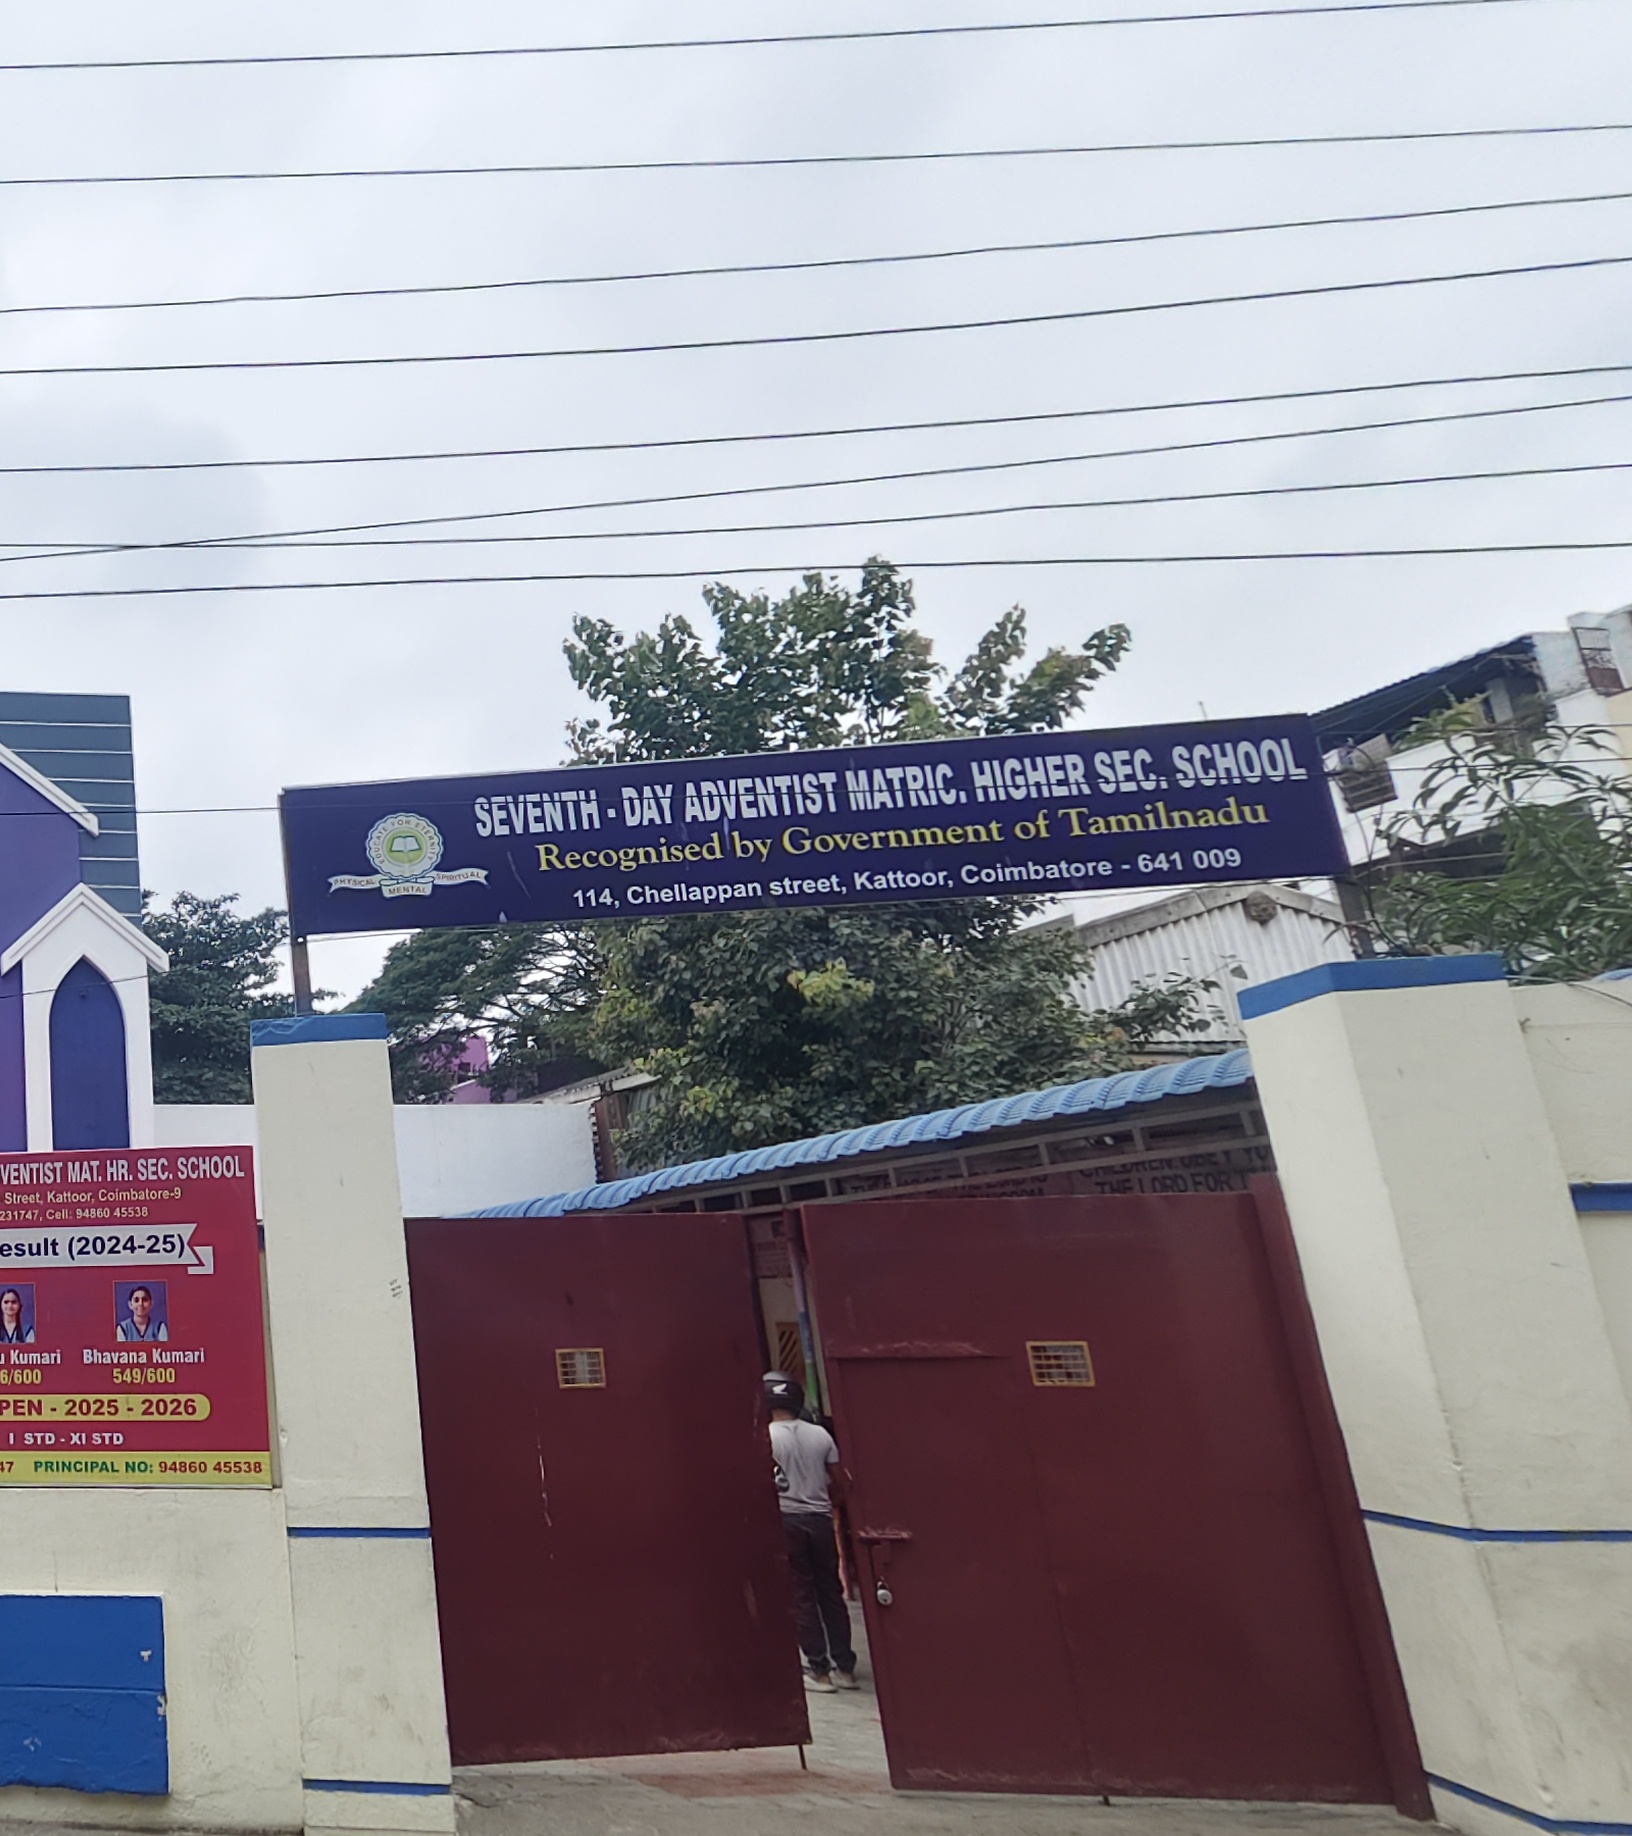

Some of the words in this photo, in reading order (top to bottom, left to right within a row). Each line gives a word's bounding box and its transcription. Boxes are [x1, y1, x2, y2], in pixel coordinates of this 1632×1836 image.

[474, 789, 600, 837] SEVENTH
[621, 784, 673, 827] DAY
[685, 770, 838, 823] ADVENTIST
[845, 763, 967, 811] MATRIC.
[971, 754, 1091, 802] HIGHER
[1094, 748, 1168, 794] SEC.
[1172, 738, 1308, 789] SCHOOL
[374, 827, 388, 865] EDUCATE
[391, 819, 412, 827] FOR
[415, 822, 438, 862] ETERNITY
[534, 831, 724, 872] Recognised
[732, 831, 772, 862] by
[782, 819, 1004, 856] Government
[1014, 810, 1052, 840] of
[1058, 796, 1270, 838] Tamilnadu
[333, 878, 378, 887] PHYSICAL
[436, 871, 482, 881] SPIRITUAL
[573, 888, 620, 909] 114,
[627, 879, 762, 905] Chellappan
[769, 873, 847, 895] street,
[854, 866, 954, 889] Kattoor,
[961, 859, 1112, 885] Coimbatore
[1137, 851, 1183, 874] 641
[1193, 848, 1241, 869] 009
[388, 886, 428, 895] MENTAL
[67, 1161, 102, 1183] MAT.
[107, 1159, 133, 1182] HR.
[137, 1157, 173, 1181] SEC.
[177, 1155, 245, 1179] SCHOOL
[1191, 1171, 1233, 1193] FOR
[5, 1192, 43, 1206] Street,
[47, 1190, 95, 1204] Kattoor,
[98, 1187, 182, 1201] Coimbatore-9
[46, 1209, 72, 1220] Cell:
[76, 1208, 110, 1219] 94860
[114, 1206, 148, 1218] 45538
[68, 1233, 185, 1260] (2024-25)
[10, 1348, 61, 1365] Kumari
[83, 1348, 147, 1364] Bhavana
[152, 1348, 205, 1364] Kumari
[112, 1368, 176, 1385] 549/600
[64, 1399, 119, 1416] 2025
[141, 1398, 197, 1416] 2026
[24, 1432, 56, 1445] STD
[70, 1433, 87, 1445] XI
[91, 1433, 124, 1445] STD
[34, 1461, 120, 1473] PRINCIPAL
[125, 1461, 154, 1473] NO:
[159, 1461, 208, 1474] 94860
[213, 1461, 263, 1474] 45538
